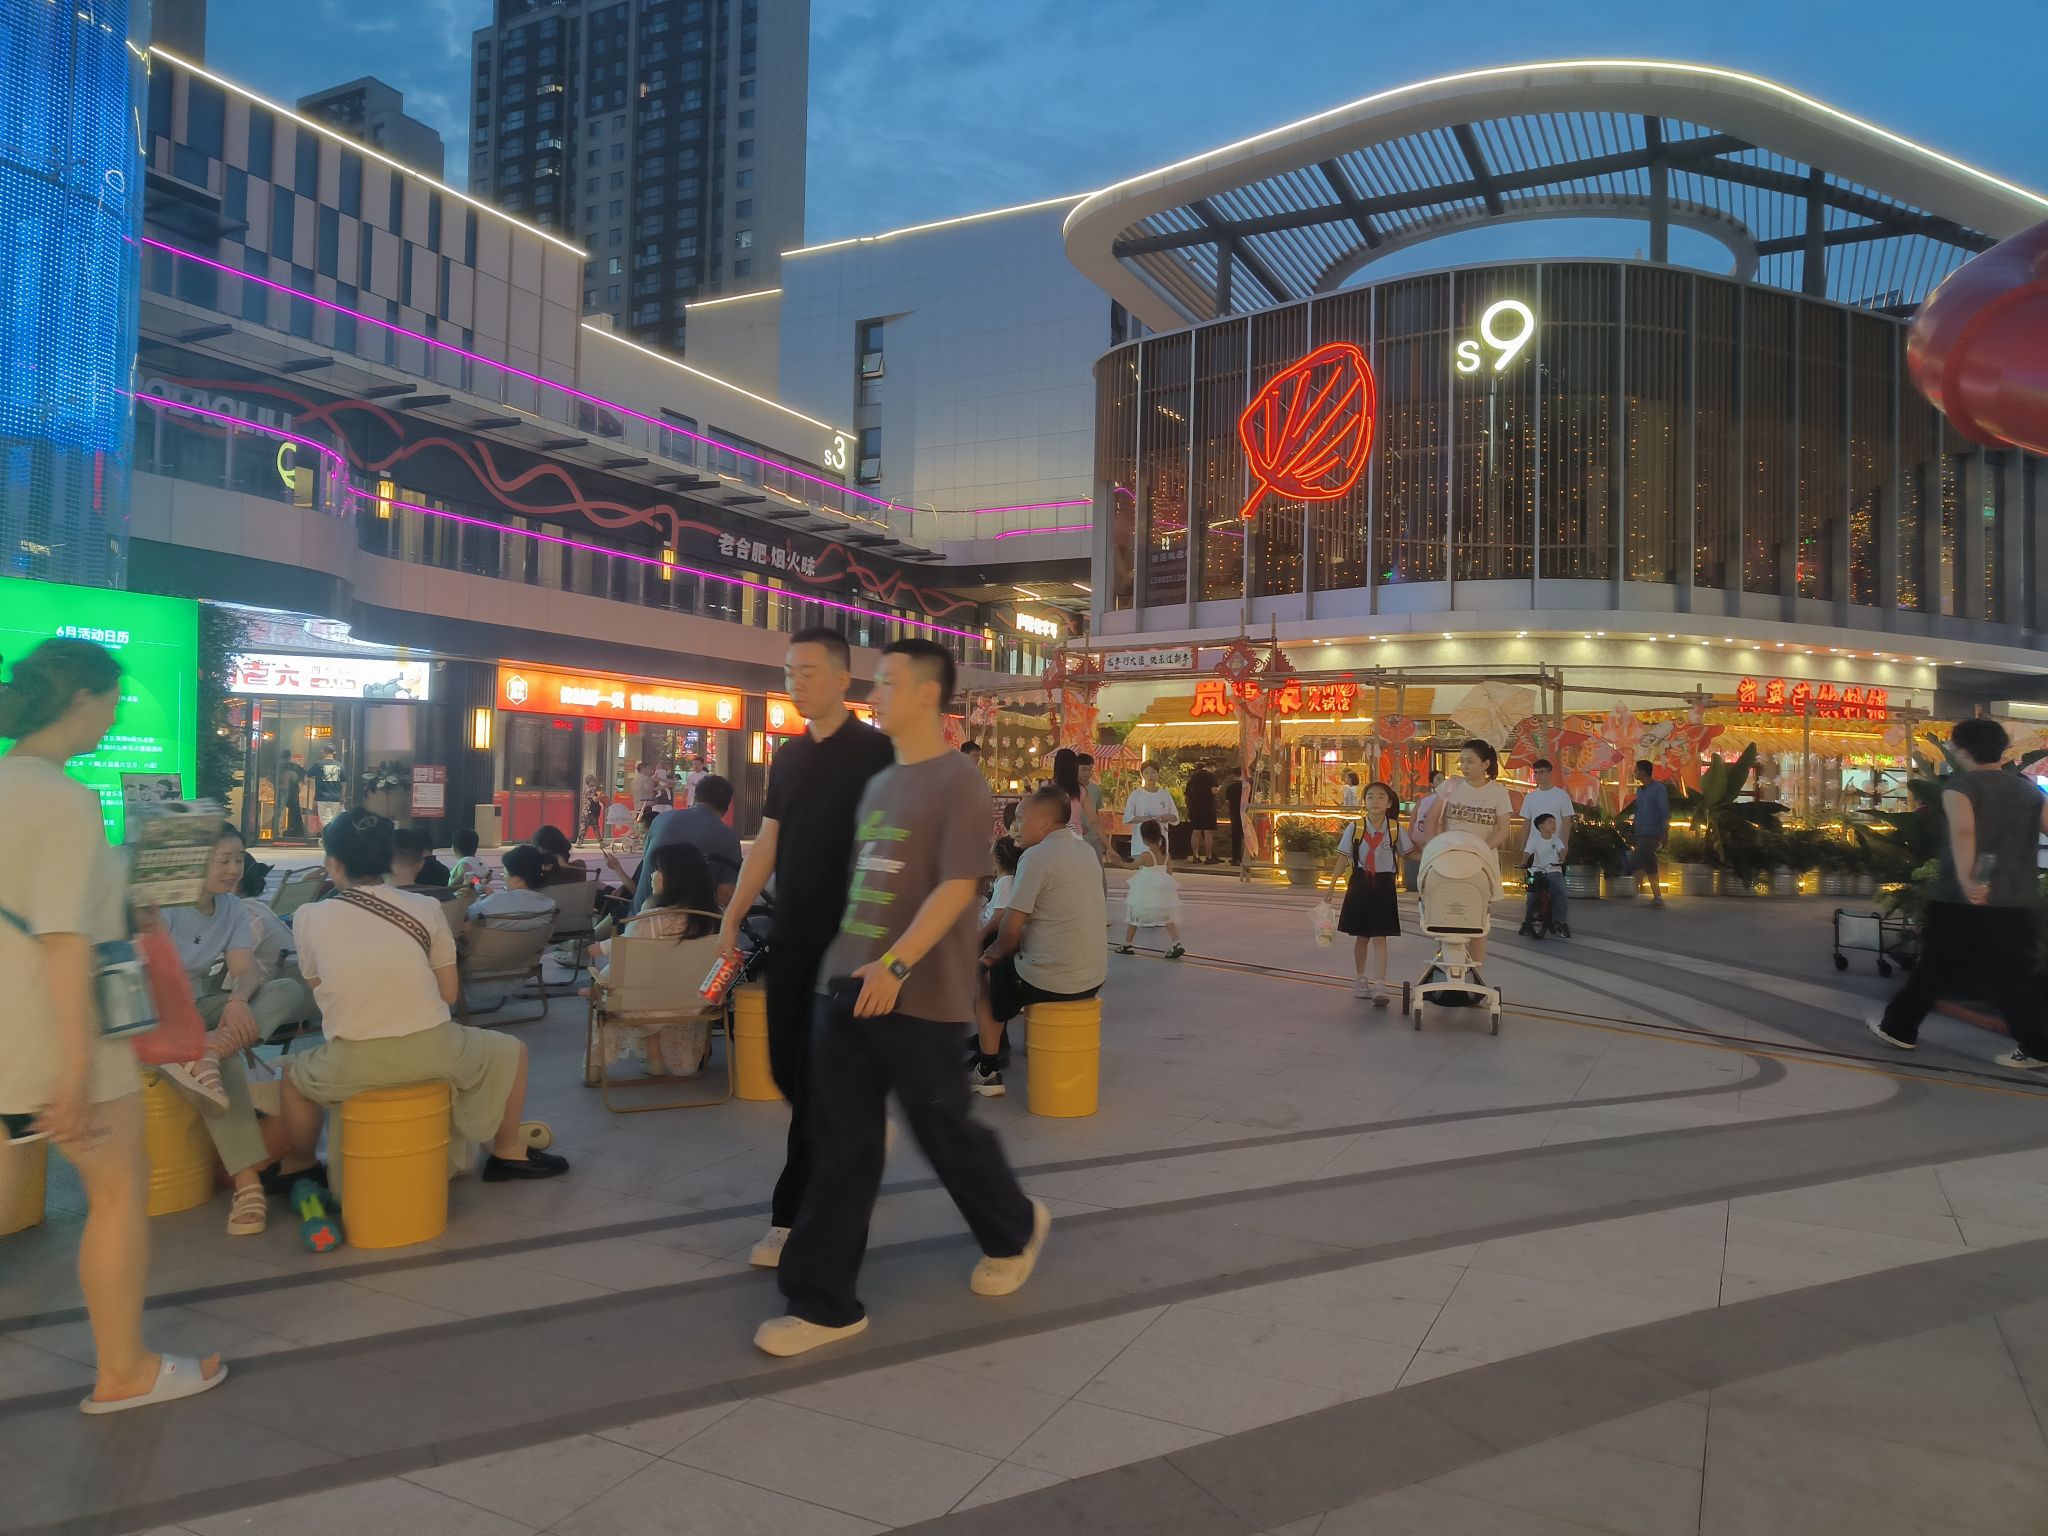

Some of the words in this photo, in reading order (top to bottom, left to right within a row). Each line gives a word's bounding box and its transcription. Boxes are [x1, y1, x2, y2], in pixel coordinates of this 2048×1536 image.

[718, 532, 767, 565] 老合肥
[771, 546, 816, 577] 烟火味
[56, 625, 130, 645] 6月活动日历
